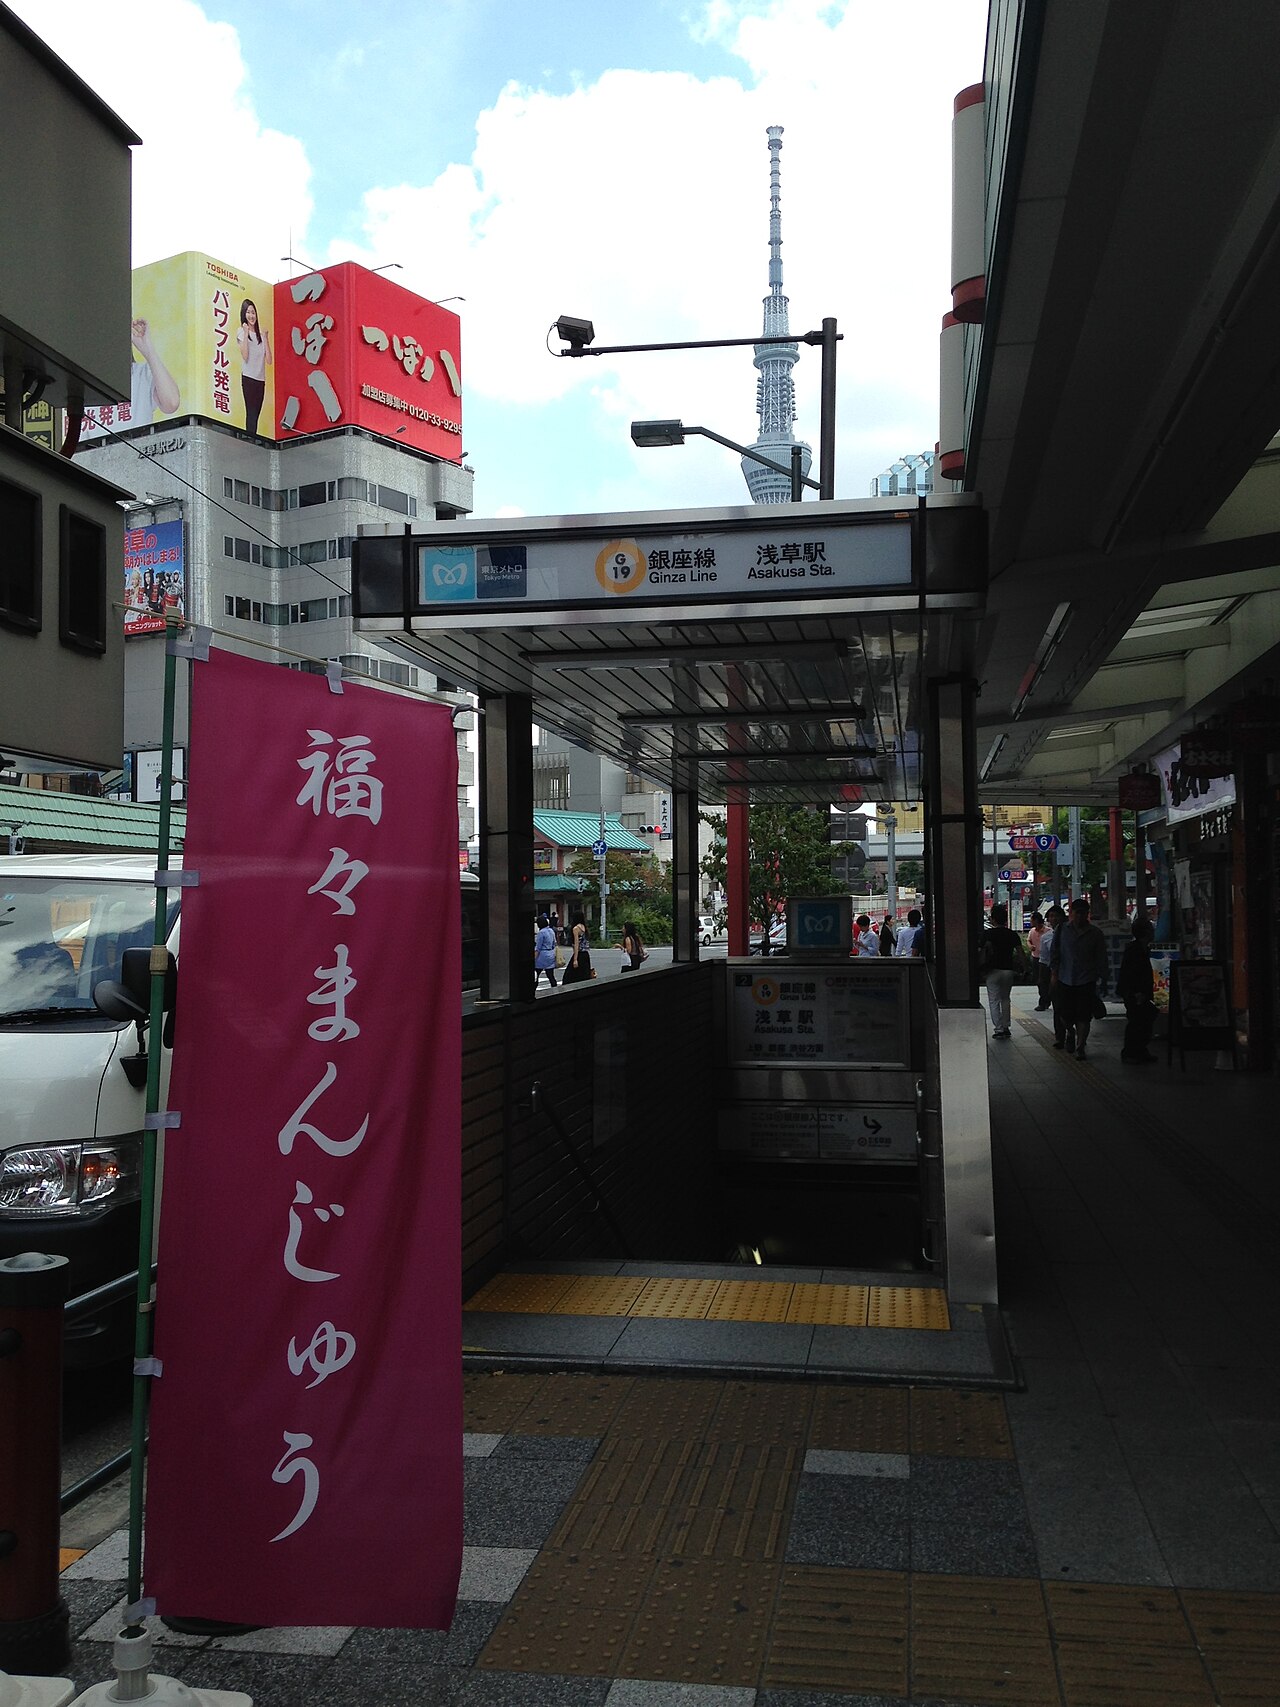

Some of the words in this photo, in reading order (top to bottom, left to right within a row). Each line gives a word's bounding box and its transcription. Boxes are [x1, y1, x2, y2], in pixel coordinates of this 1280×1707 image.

[206, 261, 239, 282] TOSHIBA
[212, 289, 231, 414] パワフル発電
[281, 274, 342, 430] つぼ八
[361, 324, 462, 398] つぼ八
[614, 553, 627, 565] G
[648, 548, 716, 570] 銀座線
[756, 542, 827, 565] 浅草駅
[481, 565, 523, 574] 東京メトロ
[612, 566, 631, 579] 19
[747, 566, 806, 580] Asakusa
[809, 564, 836, 577] Sta.
[648, 571, 686, 584] Ginza
[690, 570, 718, 582] Line
[1040, 836, 1048, 846] 6
[740, 975, 749, 985] 2
[761, 990, 771, 998] 19
[780, 982, 816, 994] 銀座線
[755, 1010, 814, 1024] 浅草駅
[754, 1024, 793, 1034] Asakusa
[797, 1024, 815, 1034] Sta.
[267, 728, 385, 1543] 福々まんじゅう
